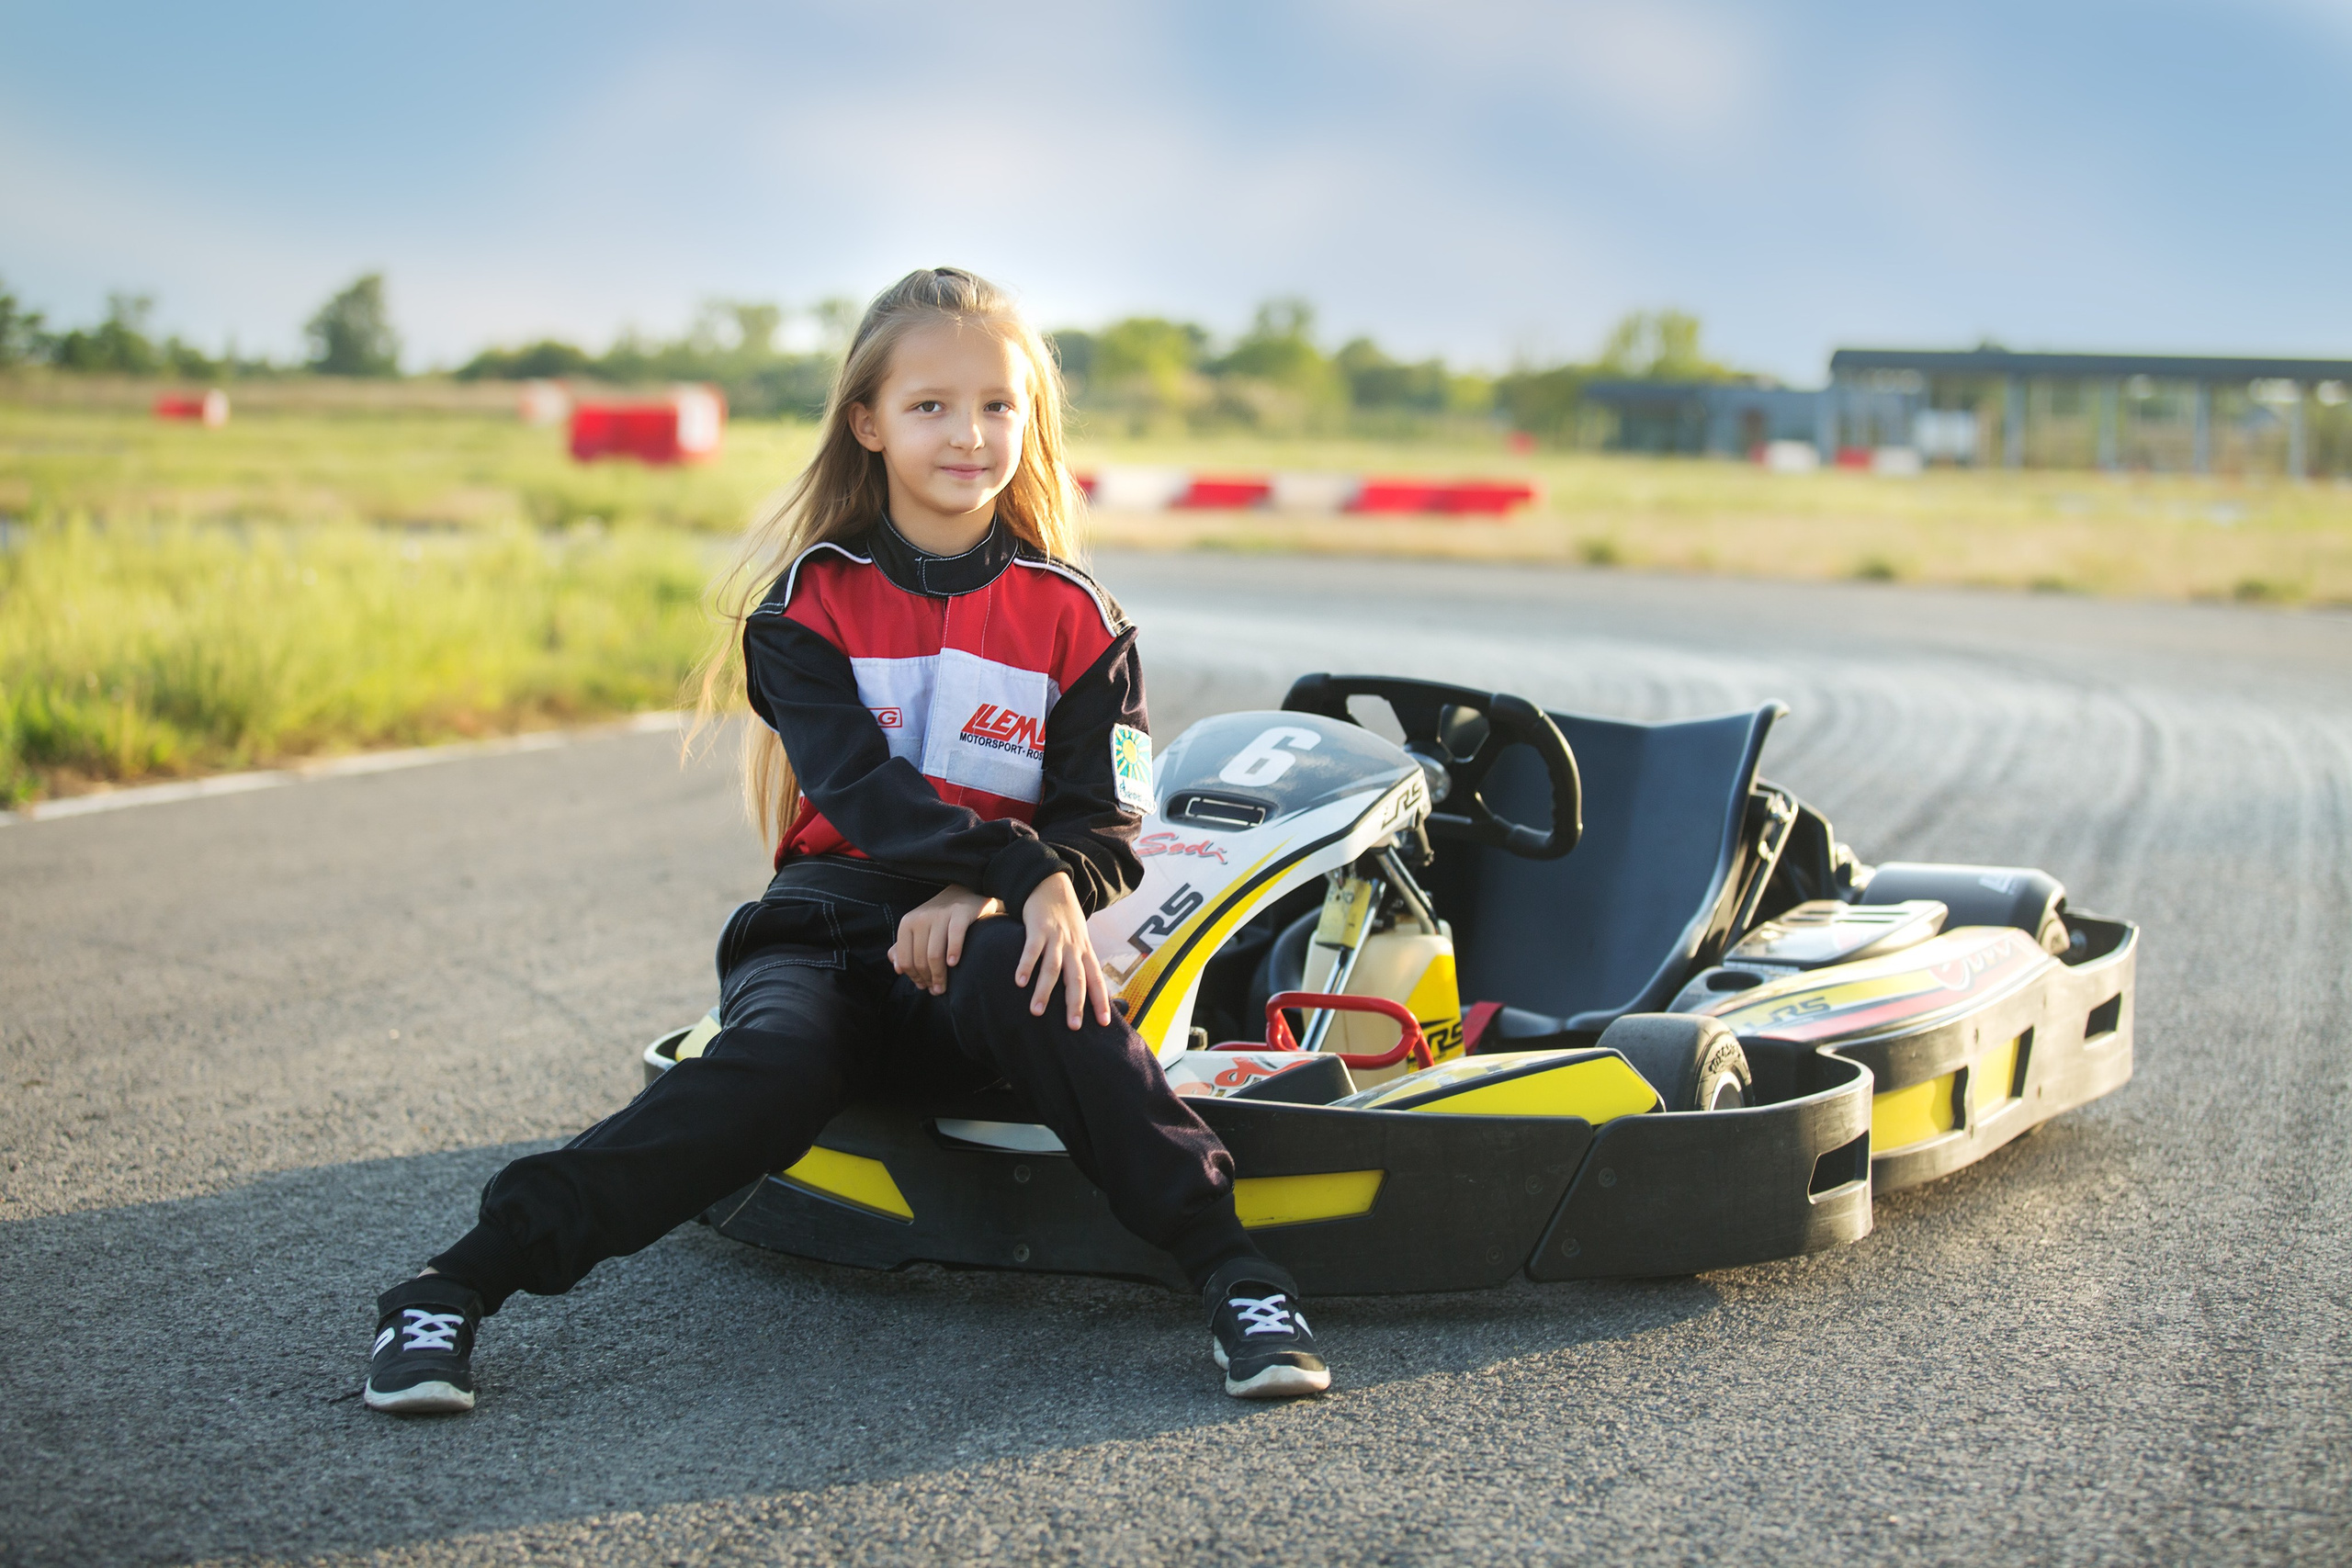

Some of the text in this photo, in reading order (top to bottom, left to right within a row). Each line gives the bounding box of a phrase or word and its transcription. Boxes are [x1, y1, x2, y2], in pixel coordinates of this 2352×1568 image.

[876, 710, 899, 726] G
[1026, 748, 1045, 761] ROS
[1218, 726, 1322, 787] 6
[1102, 882, 1204, 987] LRS
